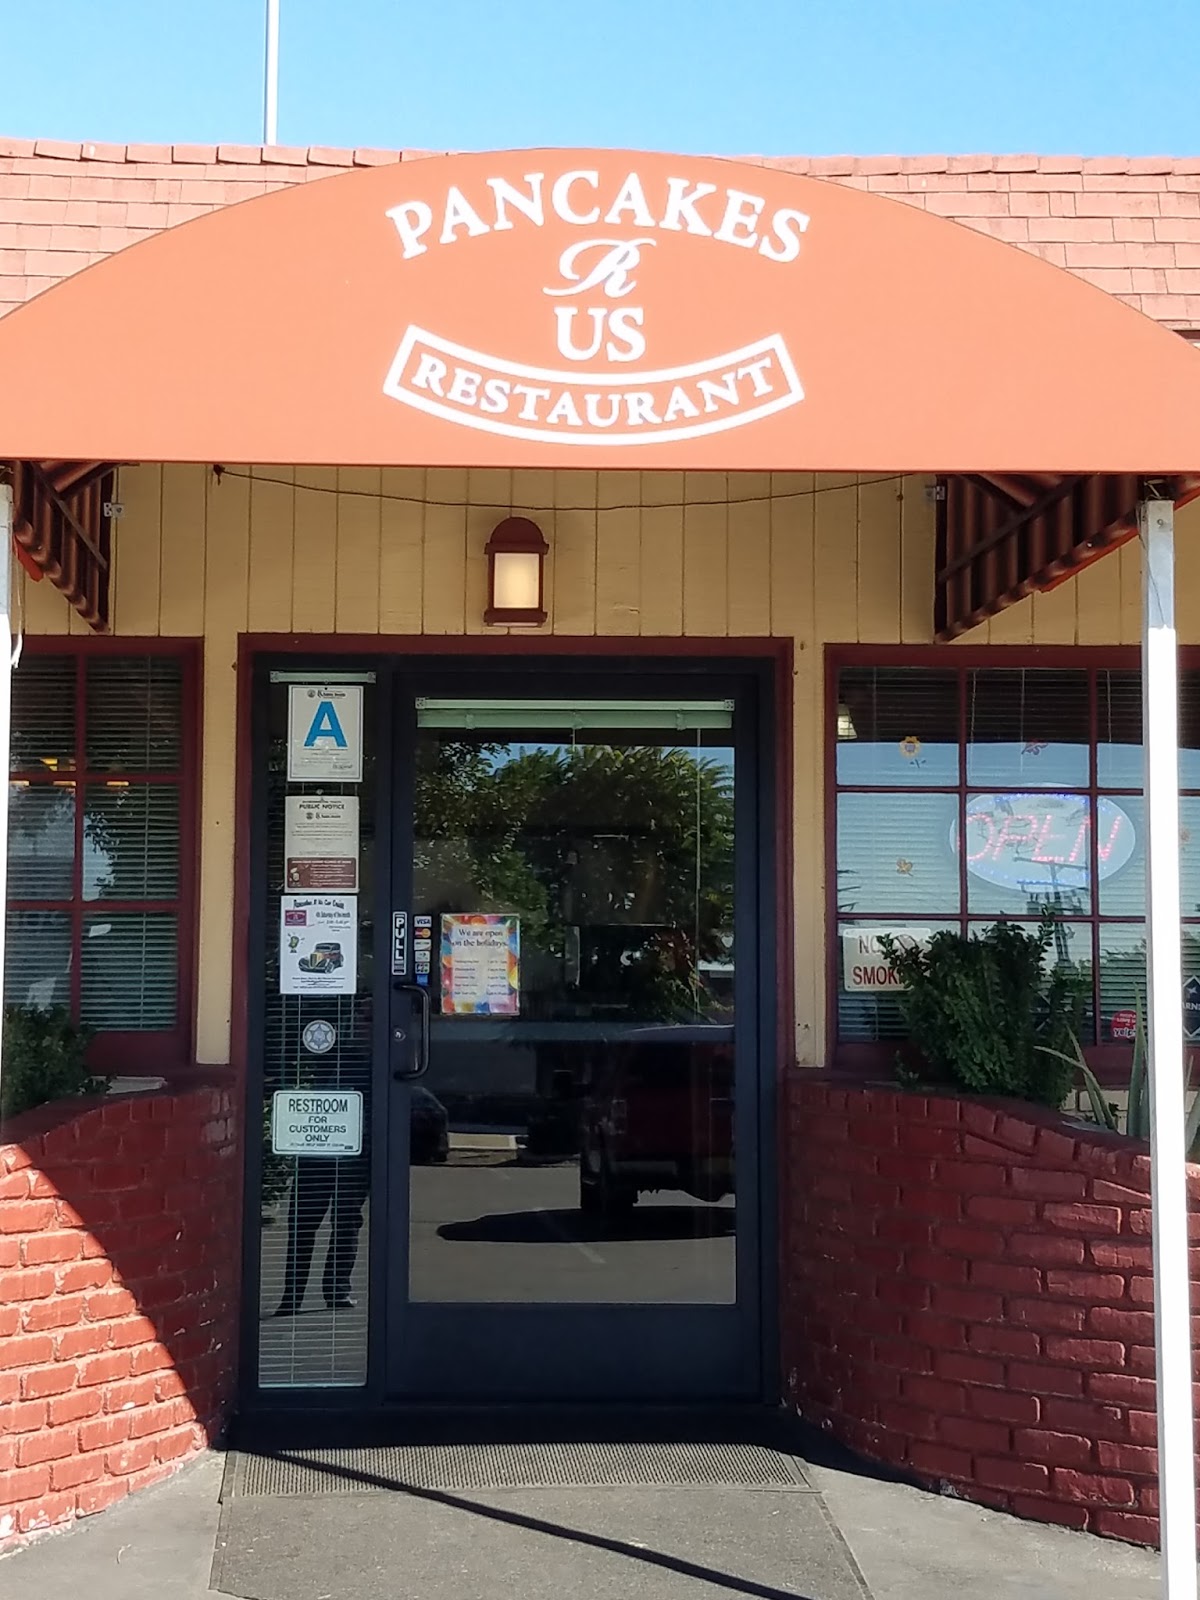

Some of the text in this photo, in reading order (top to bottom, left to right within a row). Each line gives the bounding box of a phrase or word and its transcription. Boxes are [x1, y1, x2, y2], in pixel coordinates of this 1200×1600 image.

[385, 170, 810, 262] PANCAKES
[543, 238, 657, 298] R
[554, 306, 646, 362] US
[411, 353, 773, 427] RESTAURANT
[304, 701, 348, 747] A
[957, 813, 1122, 862] OPEN
[395, 917, 405, 960] PULL
[458, 928, 470, 936] We
[485, 930, 503, 938] open
[463, 939, 475, 947] the
[852, 965, 903, 986] SMOK
[288, 1098, 348, 1112] RESTROOM
[308, 1116, 328, 1124] FOR
[289, 1125, 347, 1133] CUSTOMERS
[305, 1134, 330, 1142] ONLY
